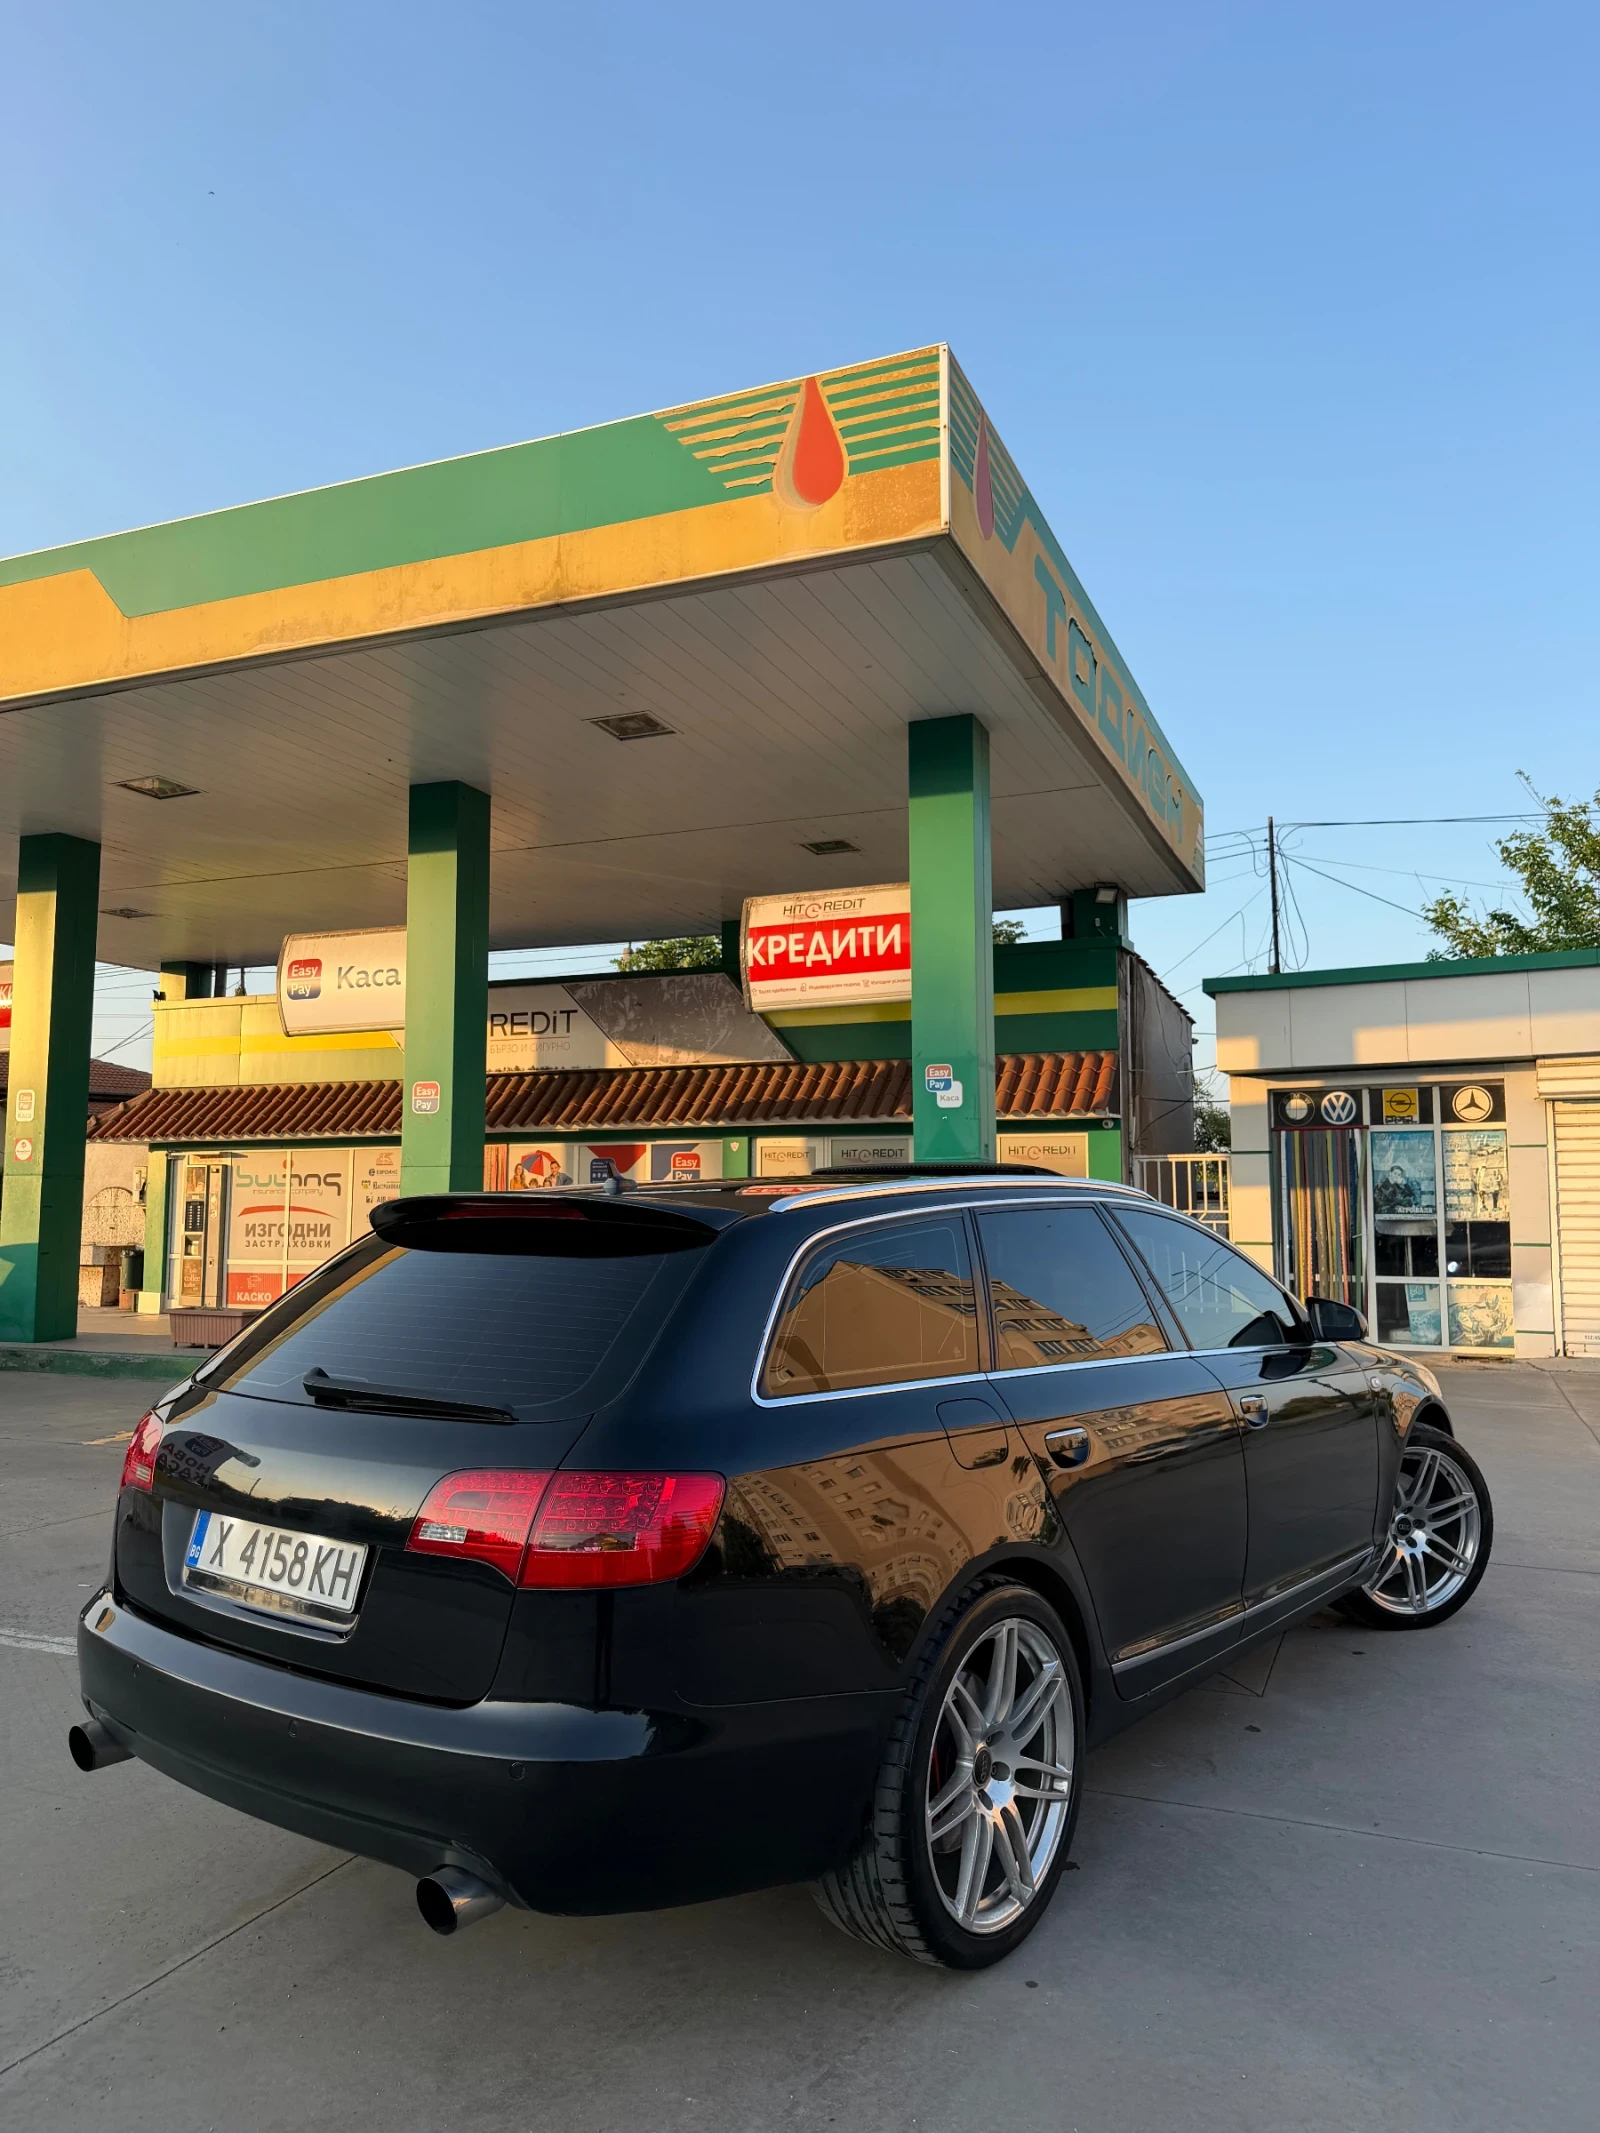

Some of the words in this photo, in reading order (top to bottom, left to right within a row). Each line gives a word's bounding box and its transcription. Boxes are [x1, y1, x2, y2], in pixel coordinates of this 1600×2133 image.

[748, 923, 902, 968] КРЕДИТИ
[291, 965, 318, 977] Easy
[337, 965, 401, 989] Каса
[291, 983, 311, 996] Pay
[490, 1043, 518, 1054] БЪРЗО
[520, 1043, 528, 1052] И
[530, 1041, 571, 1052] СИГУРНО
[929, 1068, 949, 1077] Easy
[929, 1080, 945, 1089] Pay
[416, 1086, 436, 1097] Easy
[939, 1094, 960, 1102] Каса
[416, 1099, 431, 1110] Pay
[675, 1157, 698, 1169] Easy
[675, 1171, 693, 1180] Pay
[245, 1223, 331, 1240] ИЗГОДНИ
[236, 1292, 272, 1302] КАСКО
[189, 1544, 201, 1559] BG
[209, 1520, 234, 1568] X
[239, 1528, 309, 1587] 4158
[308, 1544, 358, 1601] KH
